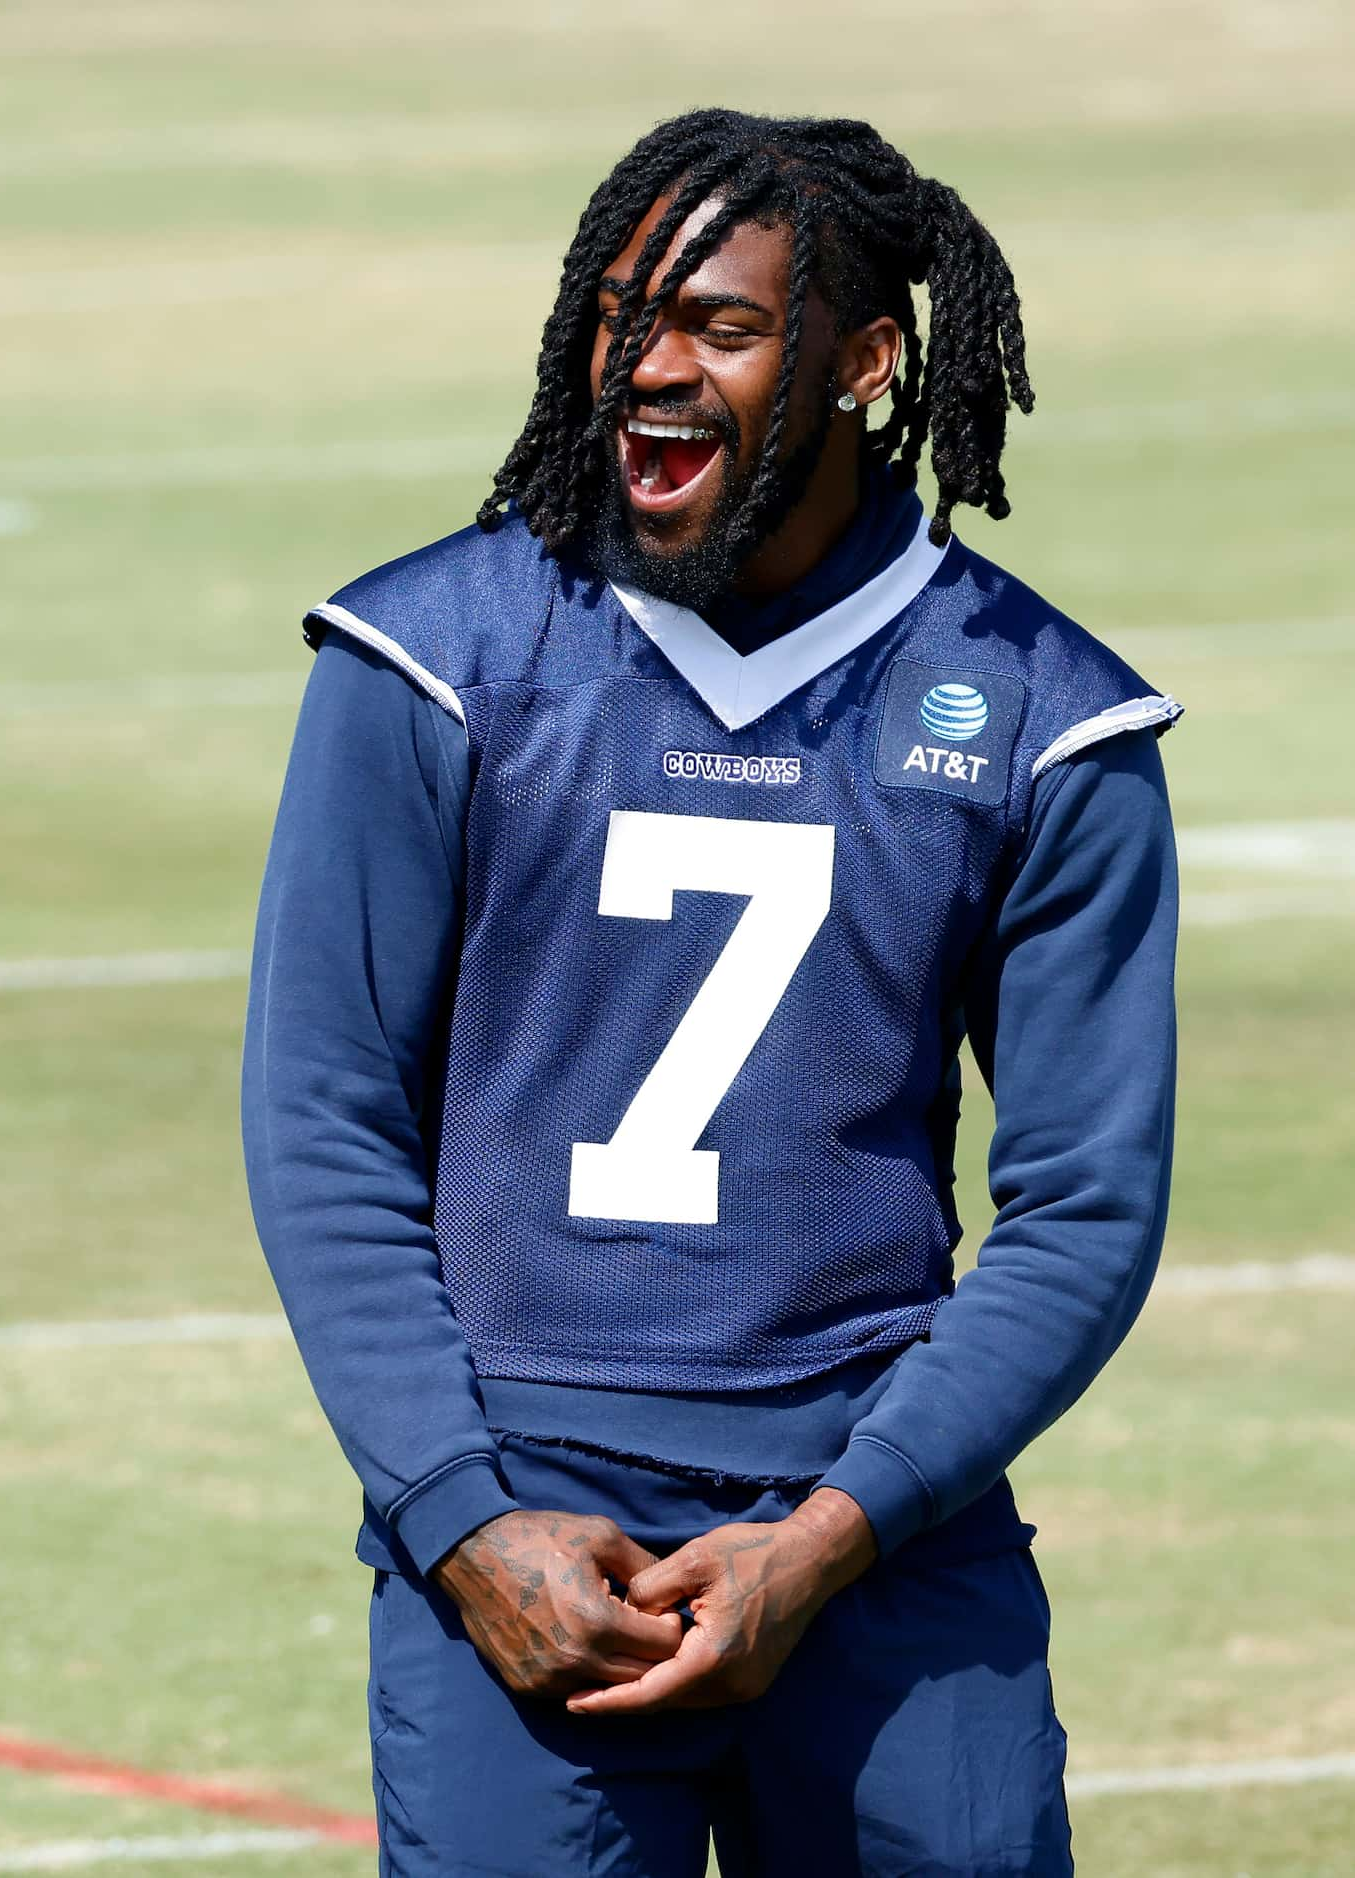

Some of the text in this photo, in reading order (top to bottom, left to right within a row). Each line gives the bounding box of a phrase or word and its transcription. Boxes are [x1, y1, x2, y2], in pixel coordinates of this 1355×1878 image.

[663, 750, 802, 784] COWBOYS
[902, 744, 990, 784] AT&T
[568, 809, 835, 1225] 7
